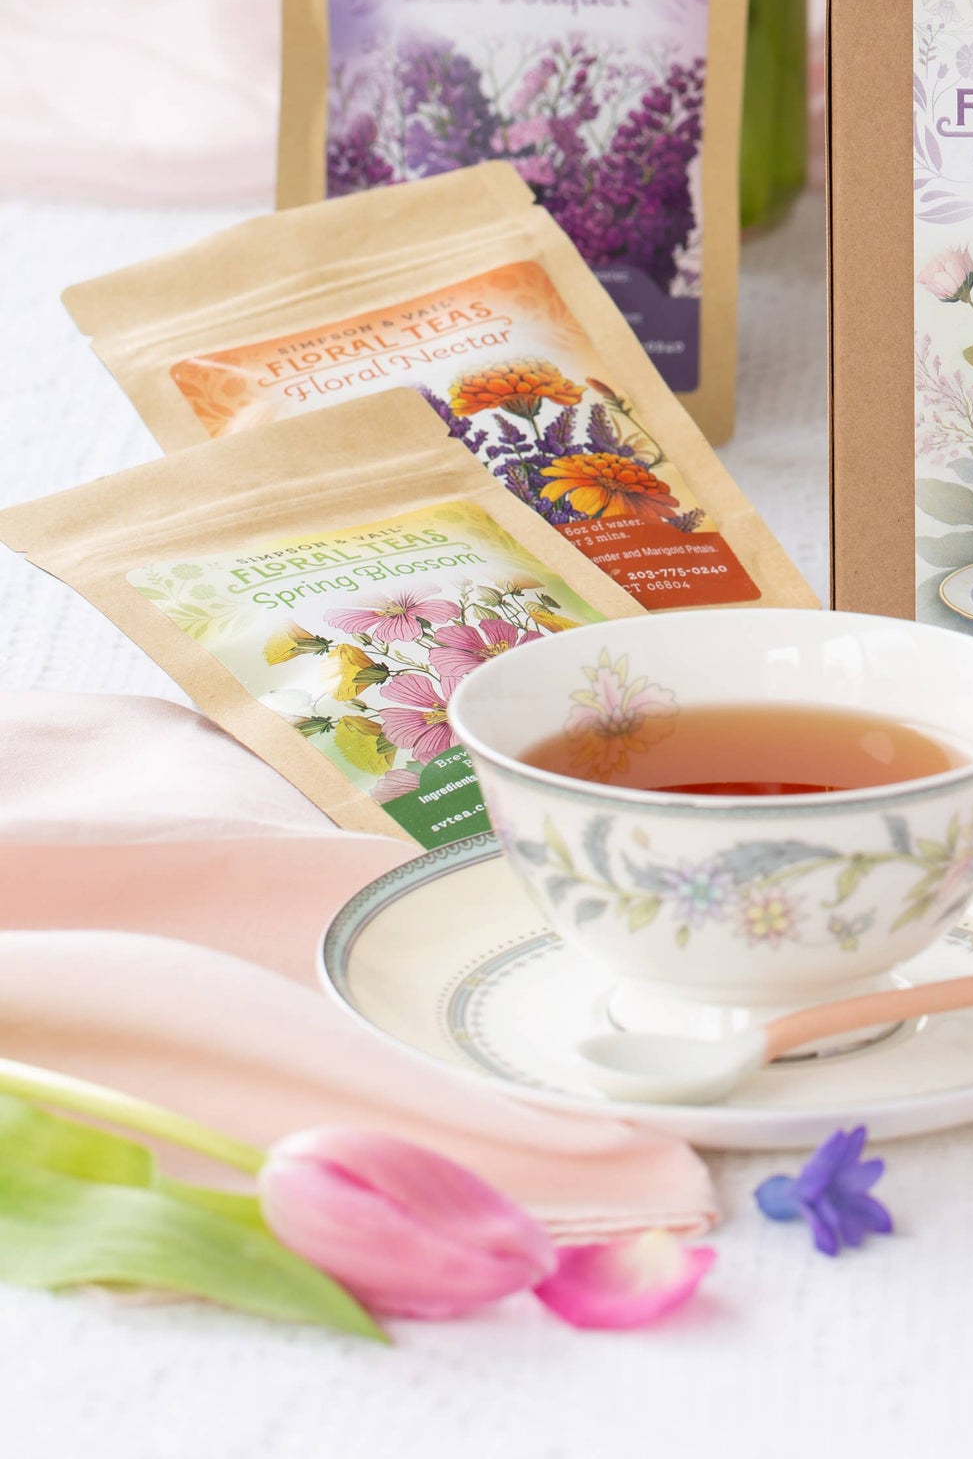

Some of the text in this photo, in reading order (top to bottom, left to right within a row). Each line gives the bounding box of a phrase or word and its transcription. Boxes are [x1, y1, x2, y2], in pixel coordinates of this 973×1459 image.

[266, 301, 493, 378] FLORAL TEAS
[277, 324, 373, 355] SIMPSON
[381, 318, 394, 328] &
[284, 330, 512, 402] Floral Nectar
[590, 521, 605, 532] of
[606, 519, 645, 529] water.
[584, 536, 594, 546] 3
[595, 532, 631, 543] mins.
[230, 529, 449, 585] FLORAL TEAS
[235, 541, 328, 566] SIMPSON
[622, 549, 642, 559] and
[641, 546, 685, 556] Marigold
[252, 551, 487, 610] Spring Blossom
[627, 565, 728, 580] 203-775-0240
[646, 580, 691, 591] 06804
